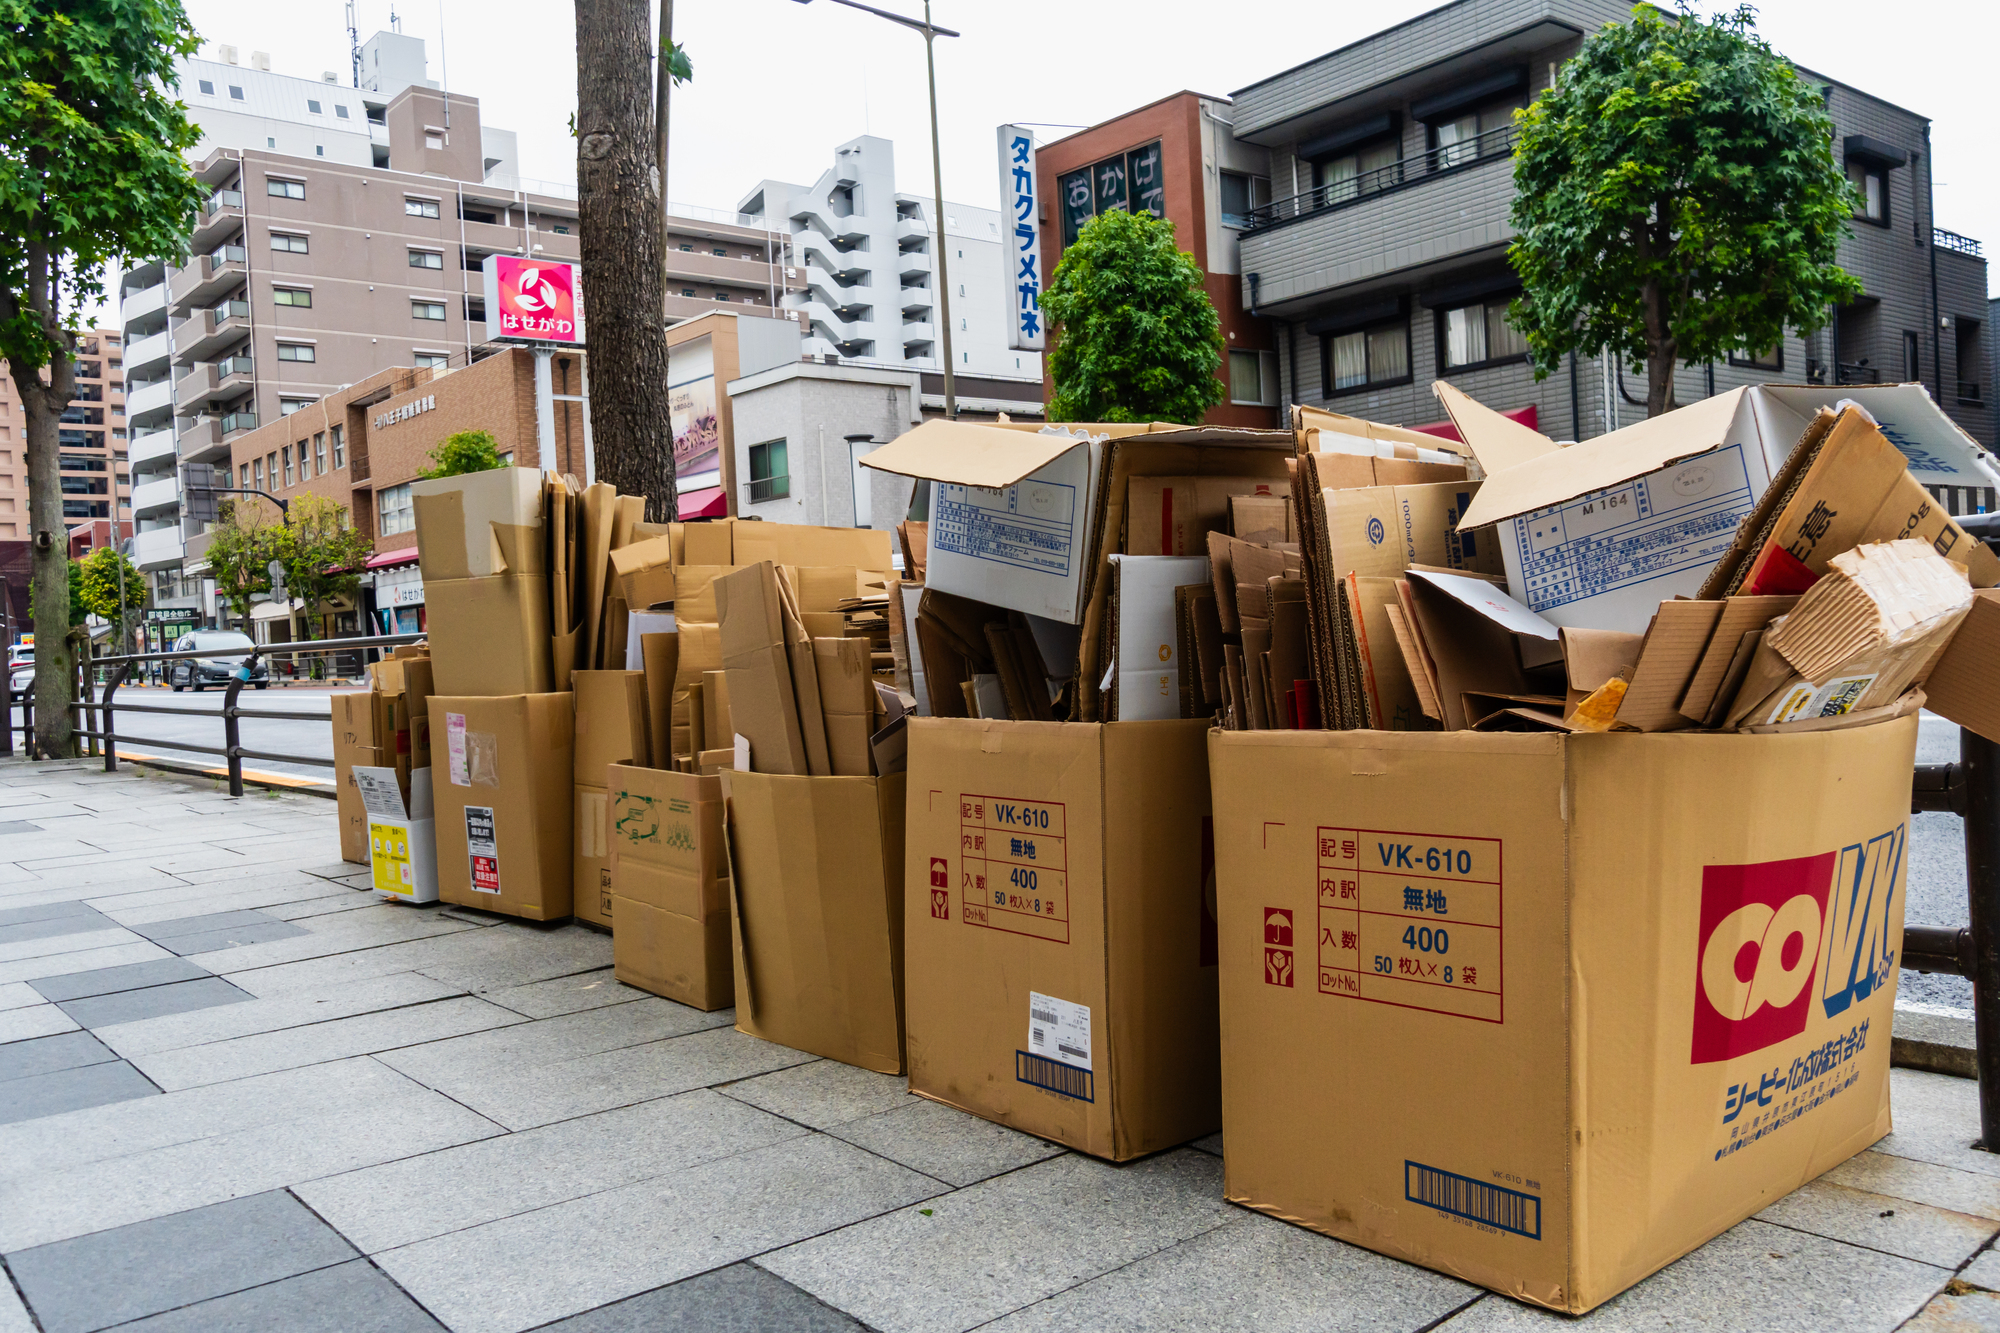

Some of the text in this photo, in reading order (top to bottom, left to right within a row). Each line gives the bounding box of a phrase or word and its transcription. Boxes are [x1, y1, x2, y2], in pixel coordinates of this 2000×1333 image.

[1011, 136, 1040, 338] タカクラメガネ
[503, 313, 573, 334] はせがわ
[1582, 493, 1628, 516] M 164
[1517, 518, 1531, 562] 農林水産省規格
[1580, 546, 1689, 584] 株式会社 岩手ファーム
[962, 802, 984, 820] 記号
[995, 803, 1049, 829] VK-610
[963, 834, 985, 852] 内訳
[1010, 837, 1037, 860] 無地
[1320, 838, 1357, 859] 記号
[1377, 842, 1472, 875] VK-610
[964, 872, 986, 890] 入数
[1010, 867, 1038, 891] 400
[1320, 878, 1357, 900] 内訳
[994, 891, 1006, 905] 50
[1402, 885, 1449, 915] 無地
[1321, 927, 1358, 951] 入数
[1402, 925, 1449, 955] 400
[1374, 955, 1393, 974] 50
[1321, 973, 1358, 993] ロットNo.
[1723, 1017, 1870, 1125] シーピー化成株式会社
[1492, 1169, 1541, 1191] VK-610 無地
[1437, 1210, 1506, 1238] 149 35168 28569 9
